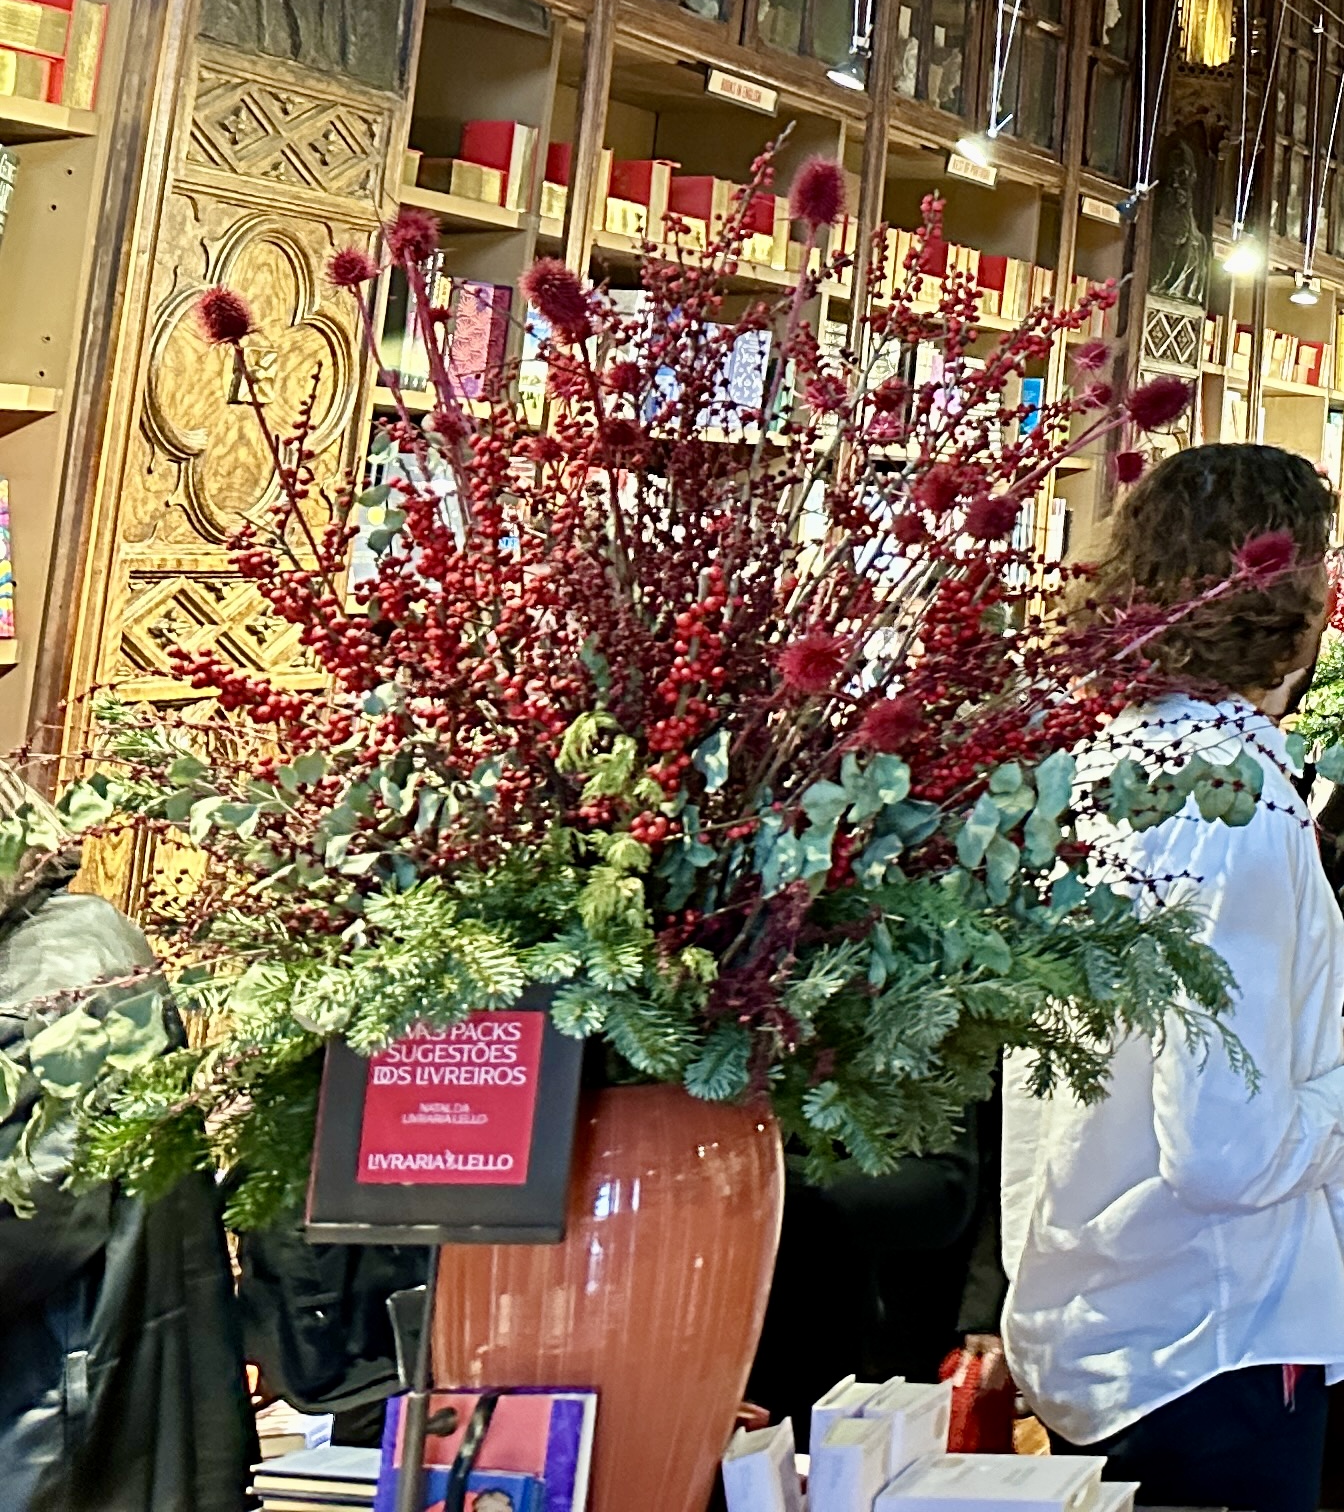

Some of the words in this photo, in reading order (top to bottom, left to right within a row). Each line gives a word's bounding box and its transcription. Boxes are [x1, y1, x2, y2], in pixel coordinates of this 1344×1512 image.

[451, 1022, 522, 1041] PACKS
[385, 1041, 518, 1063] SUGESTÕES
[373, 1066, 412, 1086] DOS
[415, 1066, 528, 1086] LIVREIROS
